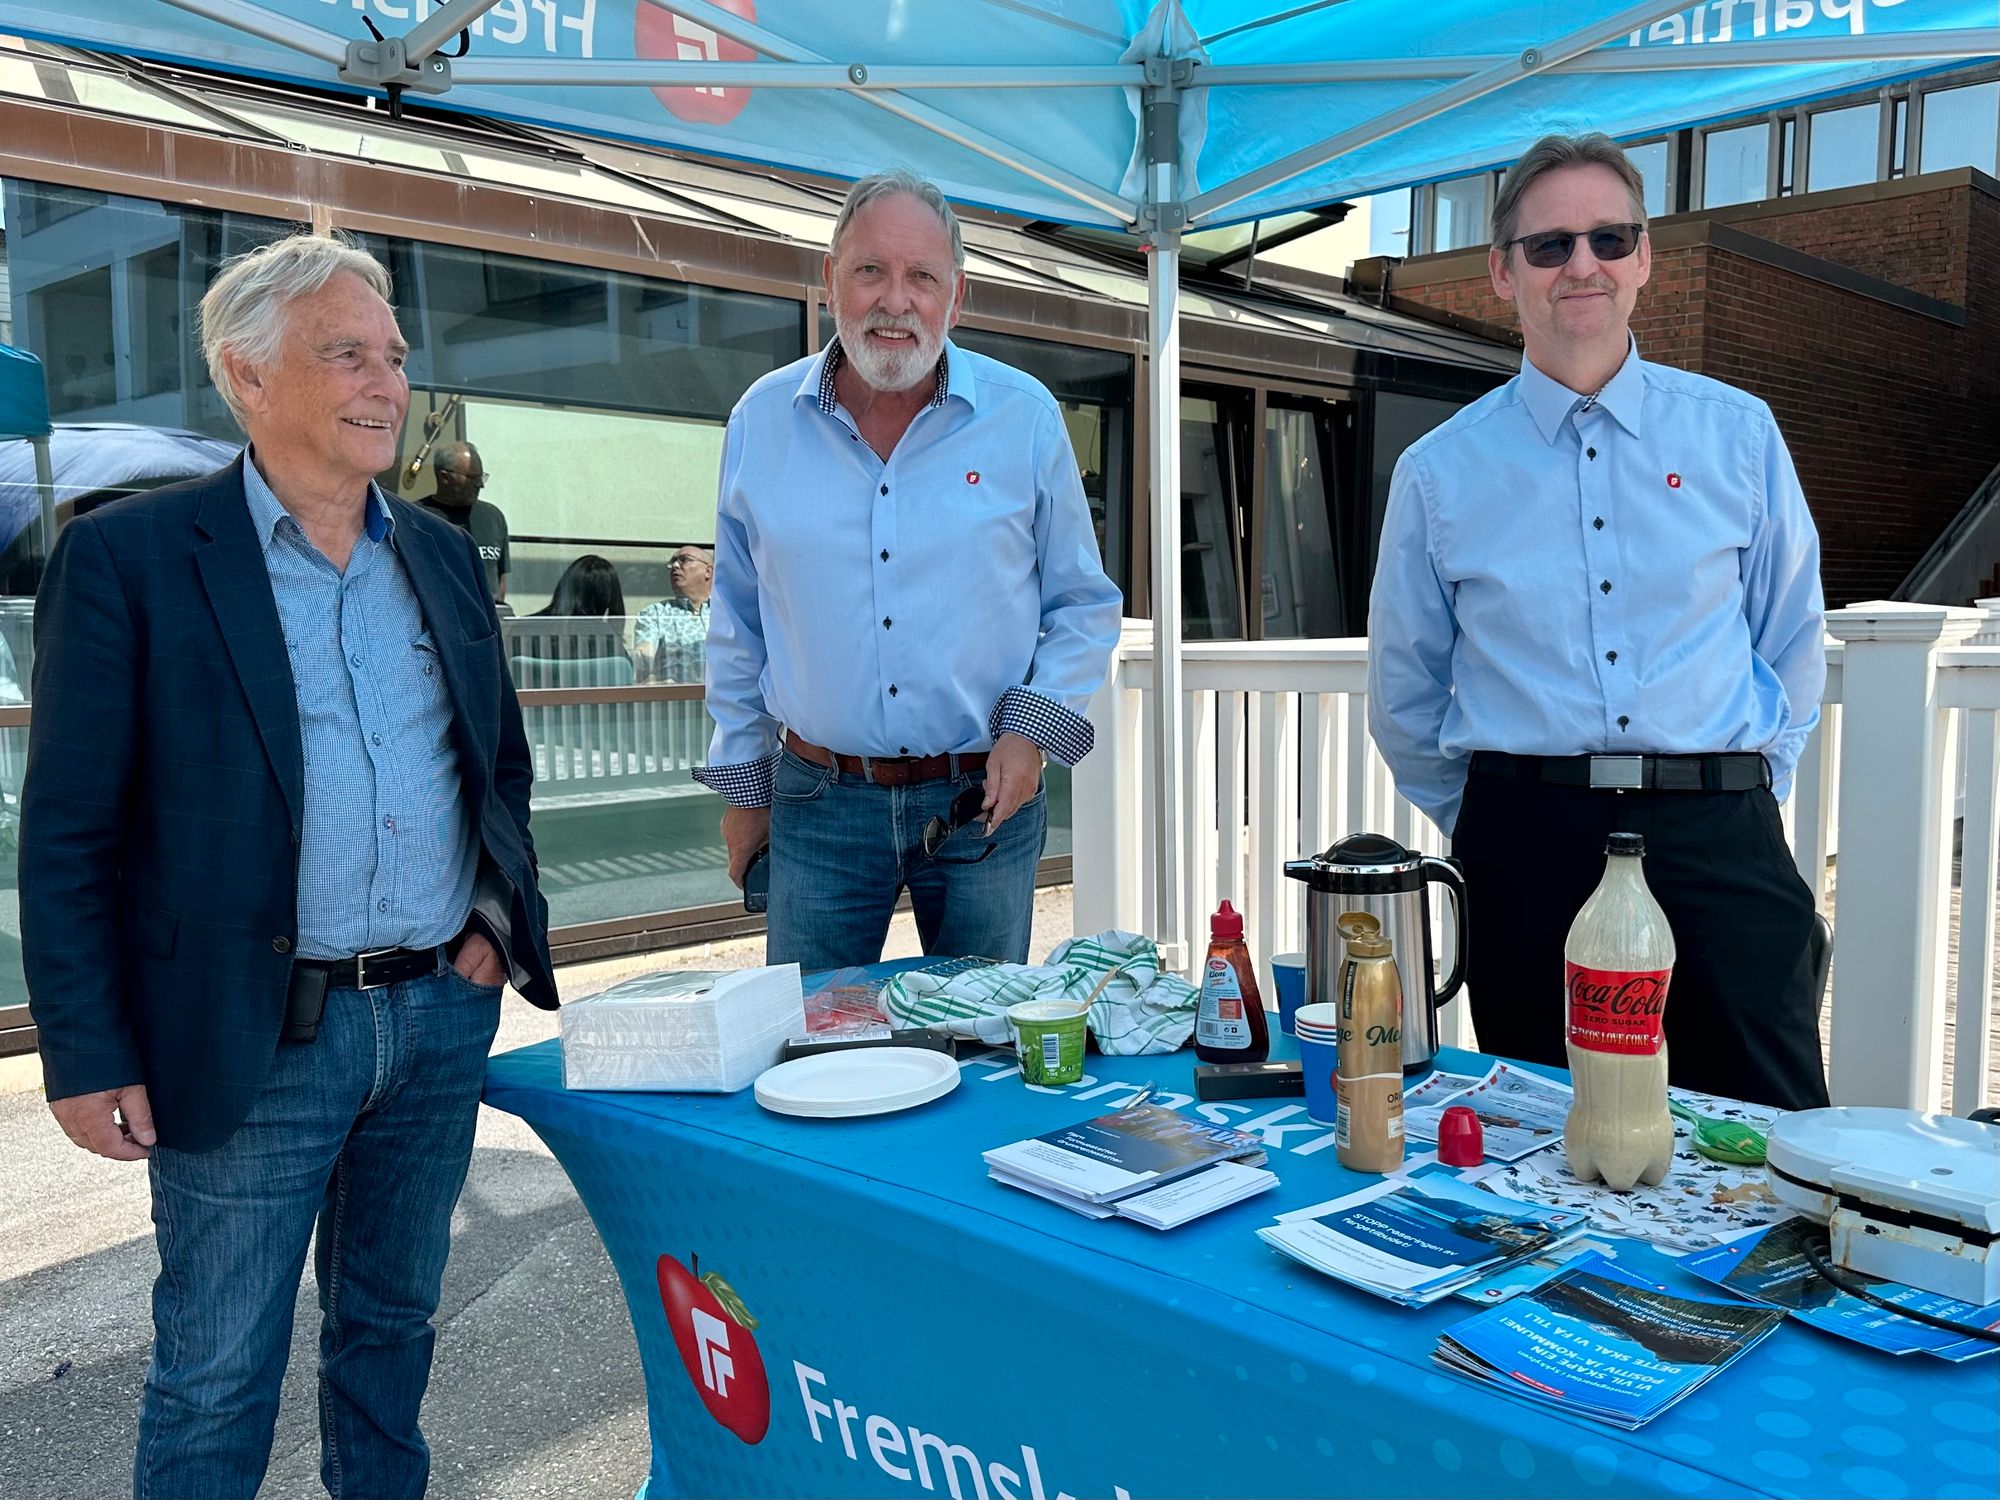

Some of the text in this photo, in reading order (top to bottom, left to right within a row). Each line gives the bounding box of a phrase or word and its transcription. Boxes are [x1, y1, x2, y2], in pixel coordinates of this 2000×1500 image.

[1570, 972, 1666, 1015] Coca-Cola
[1584, 1015, 1646, 1026] ZERO SUGAR
[1577, 1026, 1649, 1046] TACOS LOVE COKE
[1352, 1213, 1389, 1229] STOPP
[1386, 1226, 1444, 1252] raseringen
[1579, 1286, 1622, 1308] kommune
[1619, 1304, 1661, 1324] Sykkylven
[1661, 1317, 1691, 1336] utvikle
[1685, 1322, 1707, 1331] med
[1572, 1336, 1590, 1347] VI
[1595, 1344, 1632, 1362] SKAL
[1530, 1345, 1653, 1392] VI VIL SKAPE EIN
[1604, 1366, 1665, 1384] POSITIV
[1633, 1358, 1682, 1374] DETTE
